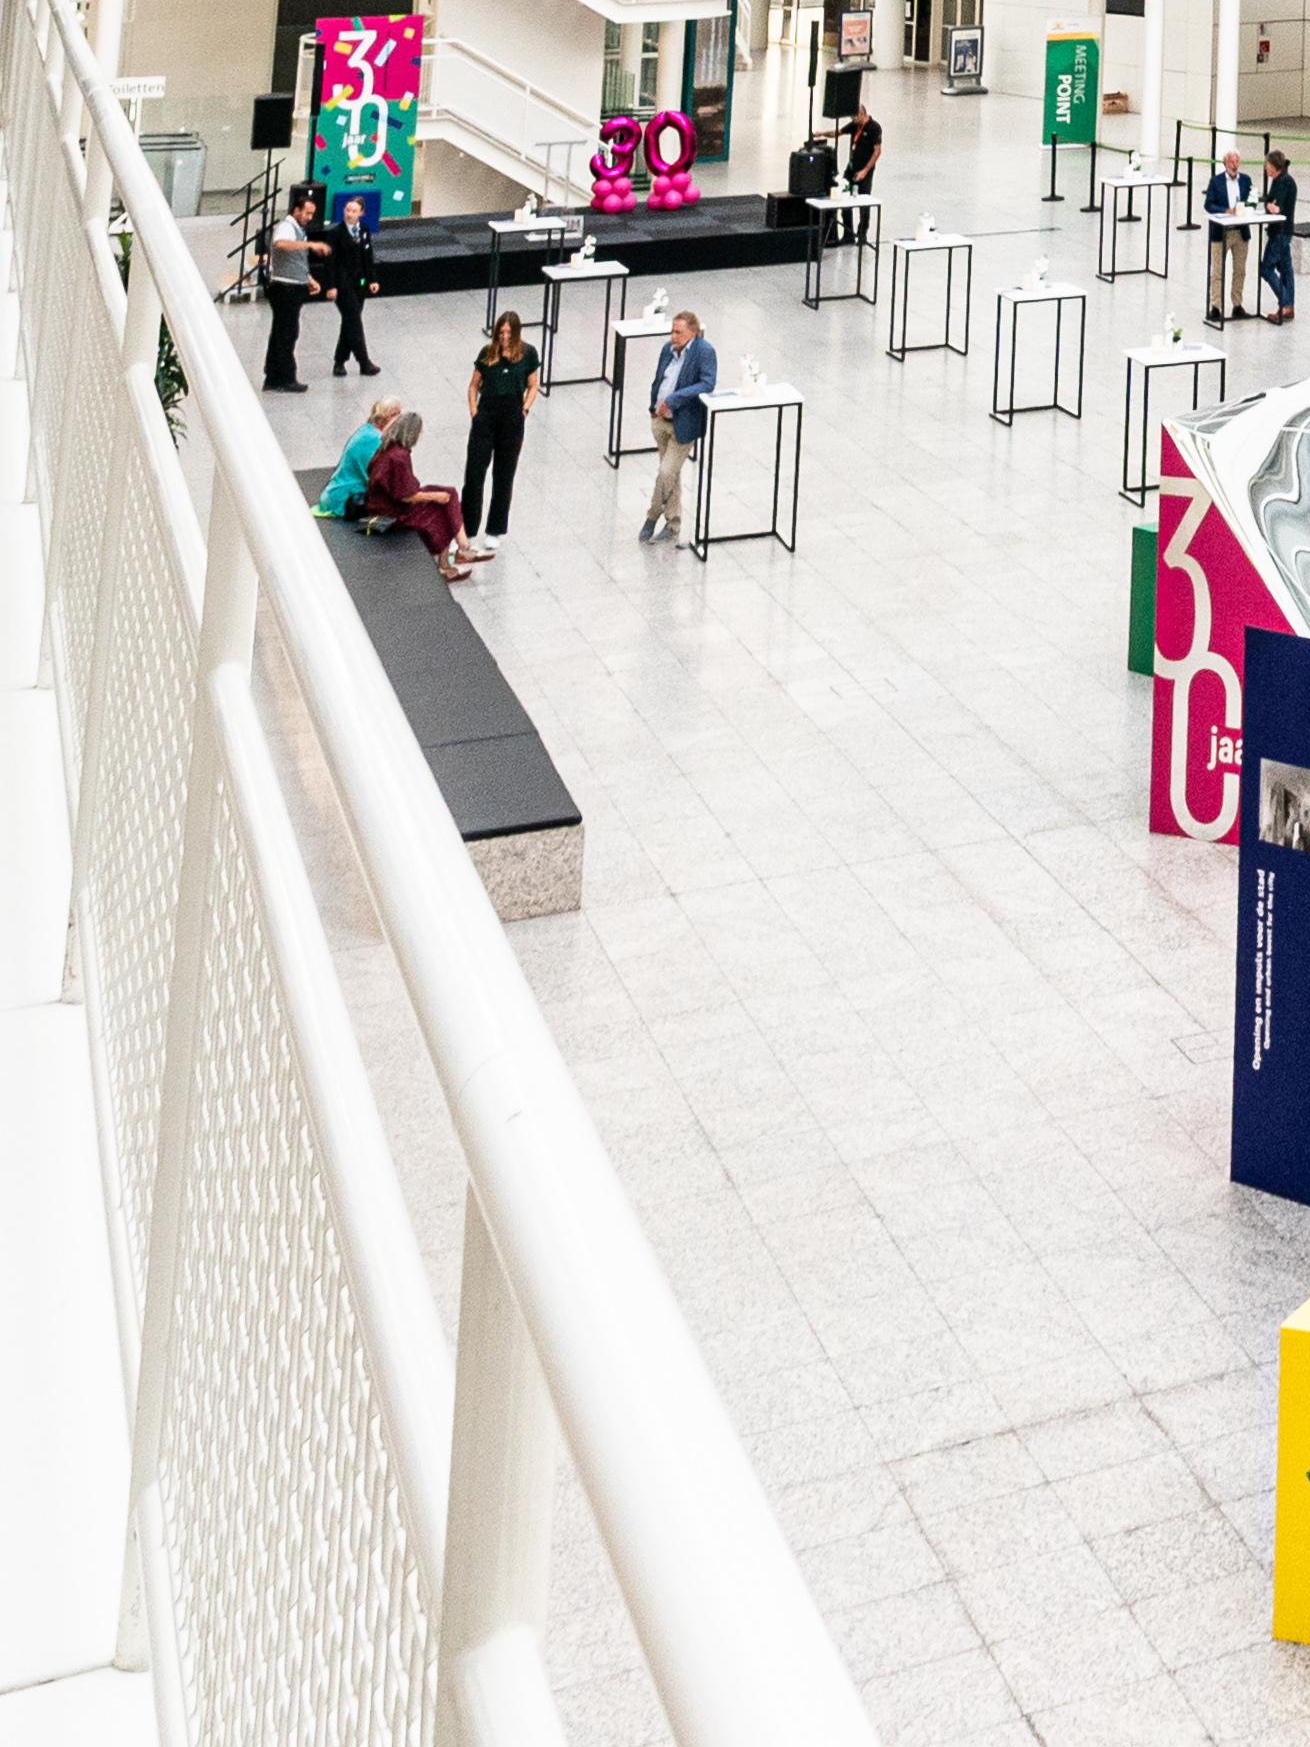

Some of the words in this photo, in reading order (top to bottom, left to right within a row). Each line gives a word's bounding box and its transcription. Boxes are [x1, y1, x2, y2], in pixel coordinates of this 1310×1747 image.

[110, 83, 165, 95] oiletten
[1073, 44, 1087, 105] MEETING
[1055, 74, 1073, 125] POINT
[589, 110, 698, 180] 30
[1207, 724, 1243, 770] jaa
[1256, 868, 1266, 898] stad
[1256, 900, 1264, 917] de
[1256, 918, 1264, 948] voor
[1255, 996, 1263, 1013] en
[1252, 1016, 1264, 1071] Opening
